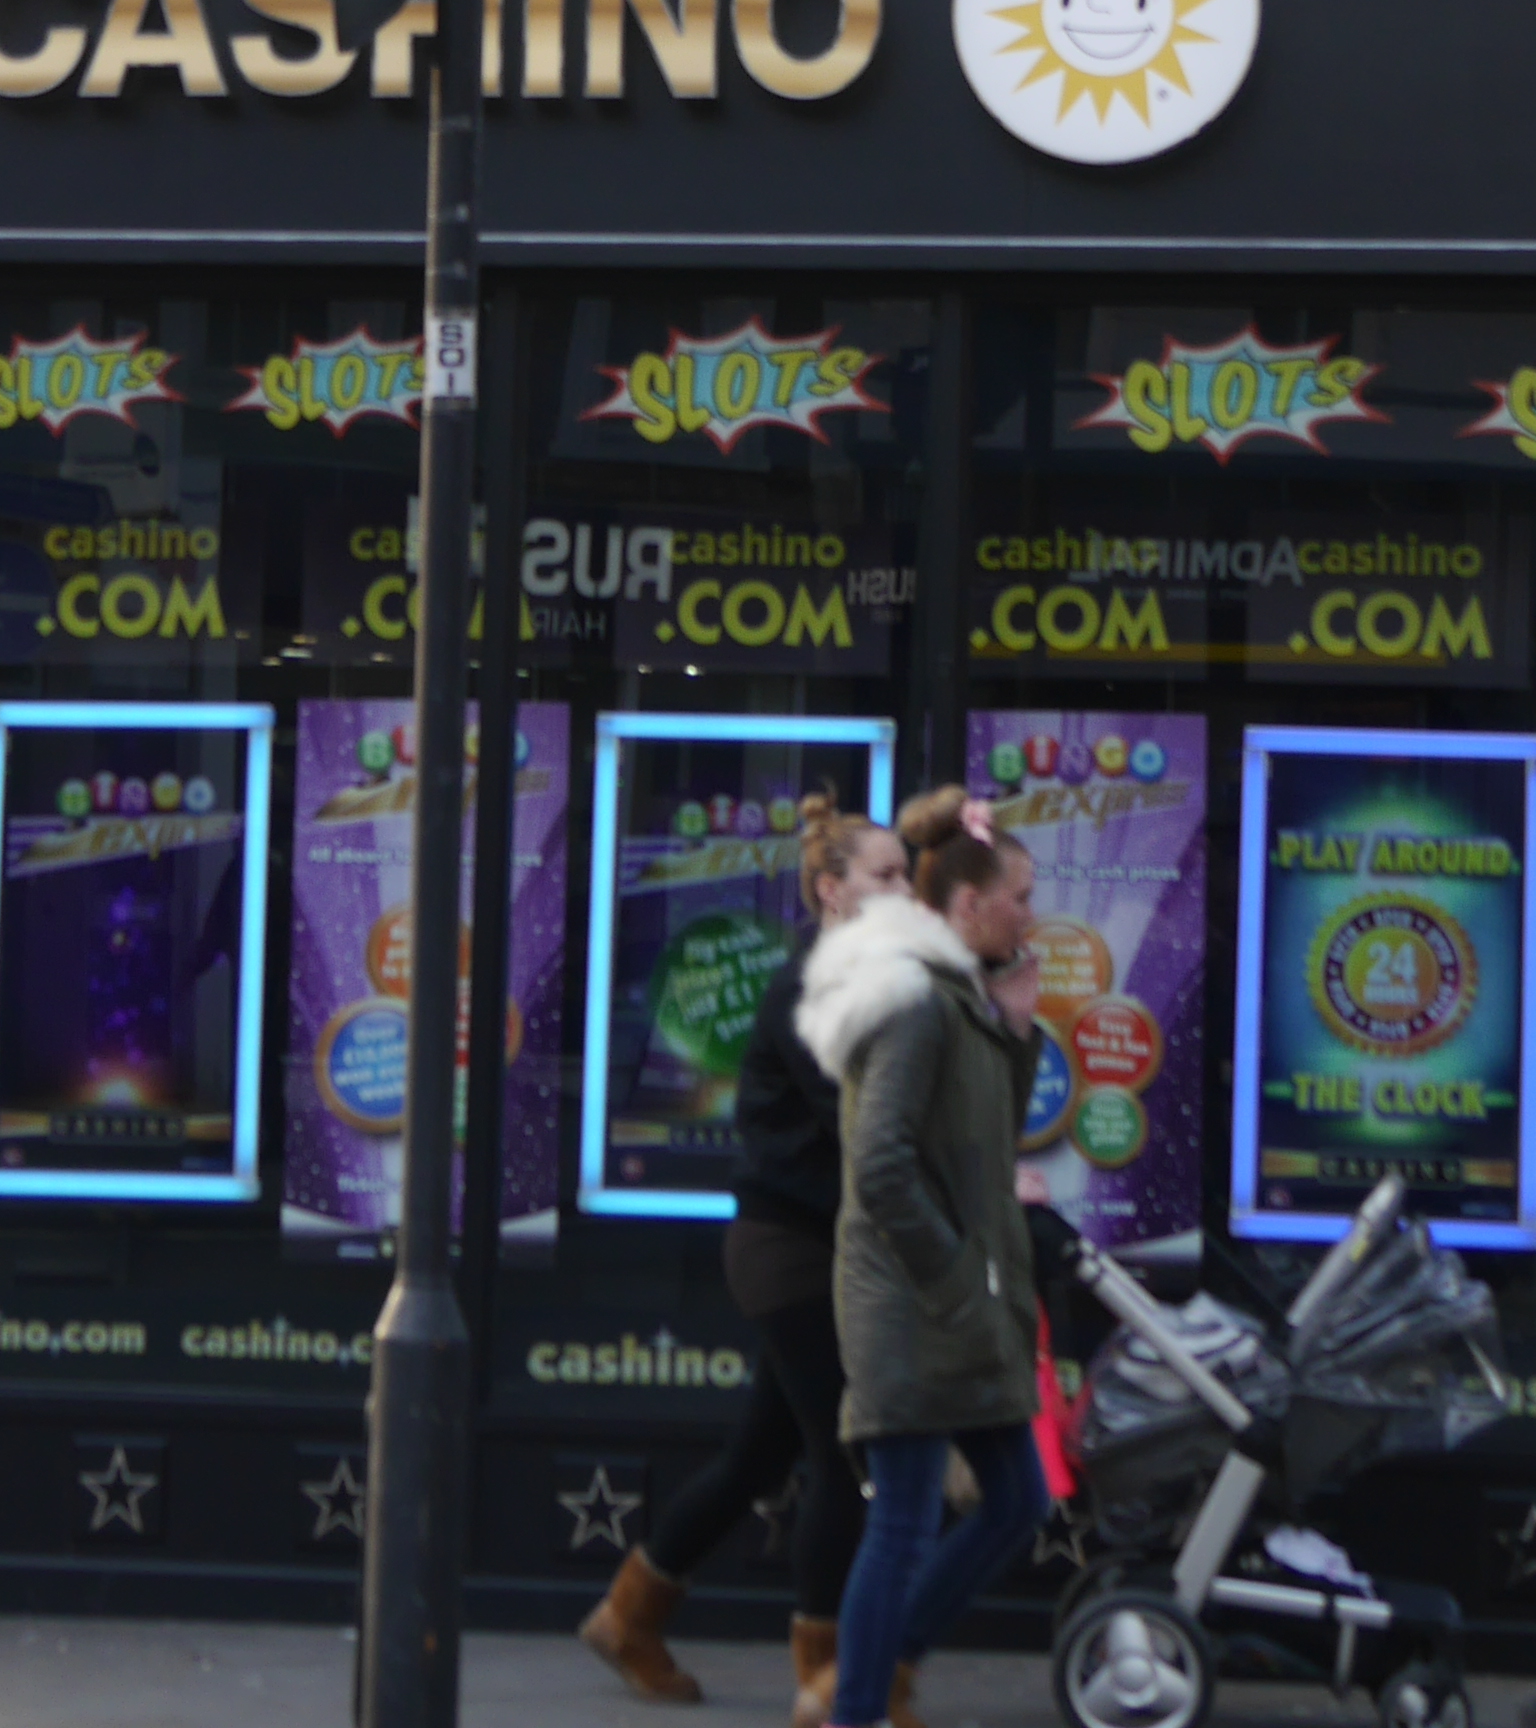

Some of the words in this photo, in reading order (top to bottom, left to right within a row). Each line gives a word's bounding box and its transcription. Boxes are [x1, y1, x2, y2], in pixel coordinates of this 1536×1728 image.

[629, 346, 867, 443] SLOTS
[1122, 356, 1363, 453] SLOTS
[44, 517, 219, 562] cashino
[669, 522, 845, 568] cashino
[1298, 533, 1483, 578] cashino
[34, 573, 227, 639] .COM
[654, 580, 854, 648] .COM
[969, 586, 1171, 652] .COM
[1289, 590, 1493, 659] .COM
[1277, 828, 1358, 871] PLAY
[1372, 834, 1512, 877] AROUND
[1367, 941, 1419, 985] 24
[1292, 1074, 1359, 1112] THE
[1371, 1079, 1486, 1118] CLOCK
[181, 1320, 374, 1368] cashino.c
[527, 1328, 753, 1388] cashino.
